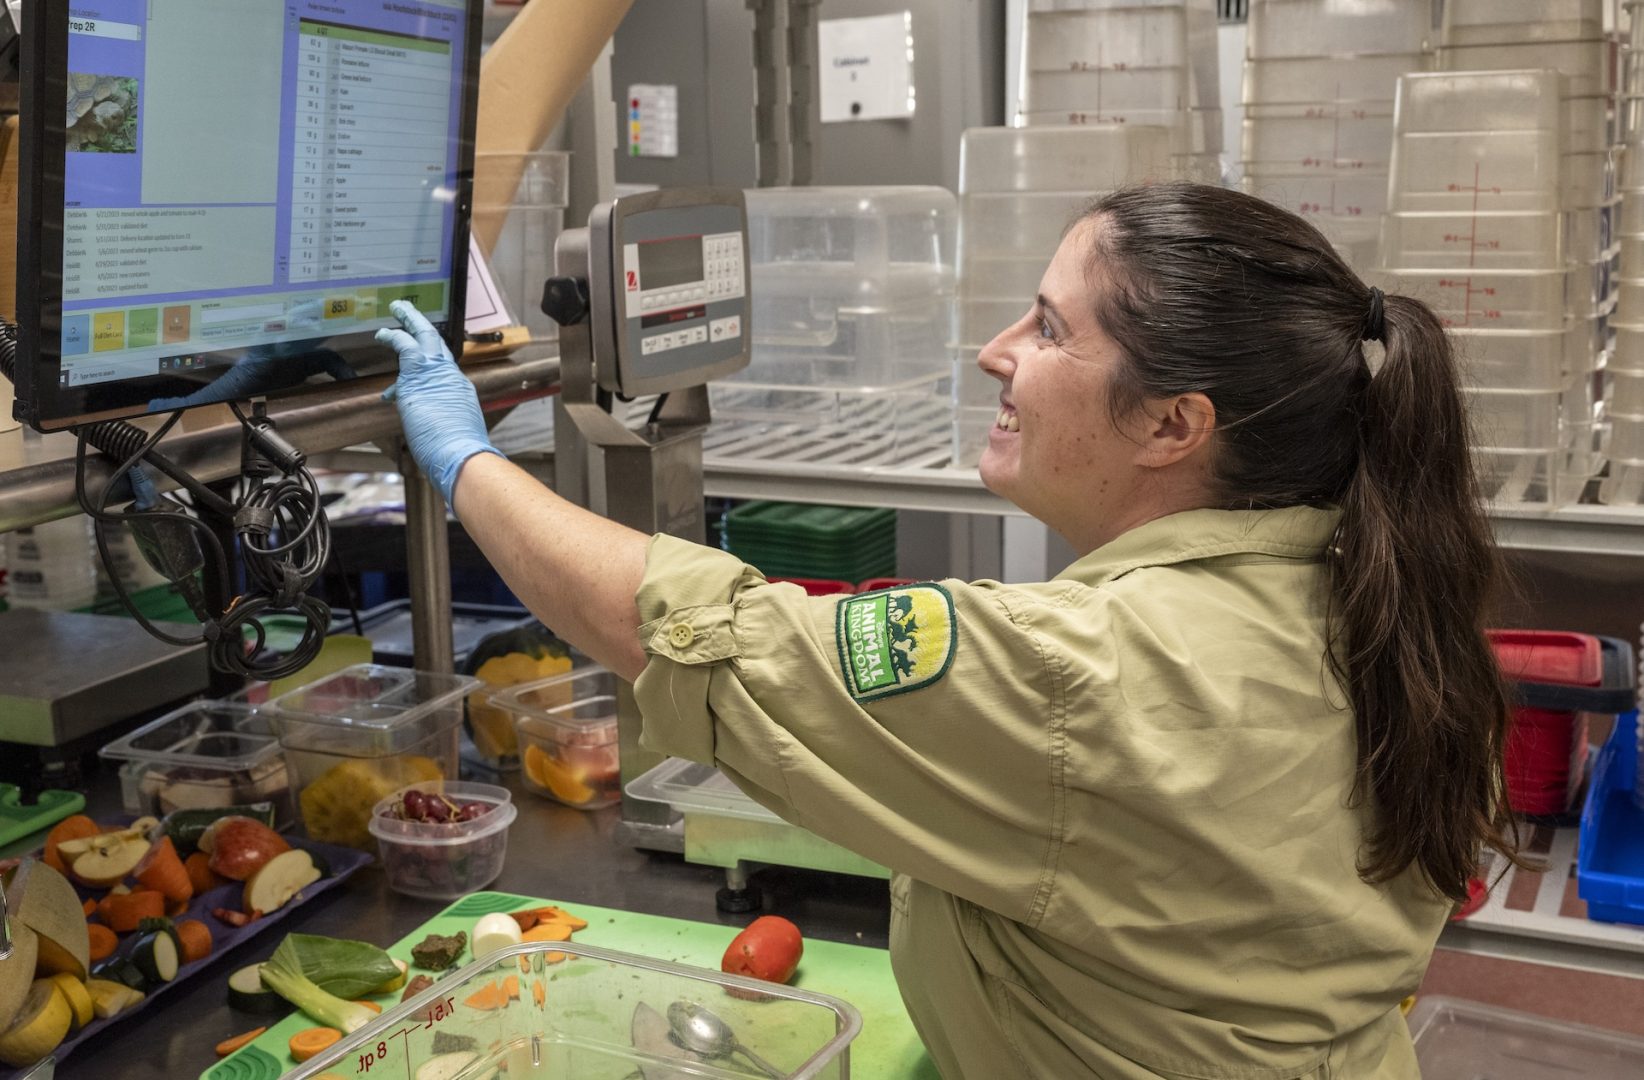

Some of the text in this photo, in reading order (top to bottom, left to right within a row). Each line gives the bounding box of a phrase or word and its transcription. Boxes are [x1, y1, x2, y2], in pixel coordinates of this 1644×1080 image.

[69, 21, 95, 32] rep 2R
[832, 56, 870, 67] Cabinet
[331, 300, 348, 314] 853
[851, 603, 870, 686] KINGDOM
[862, 602, 885, 682] ANIMAL
